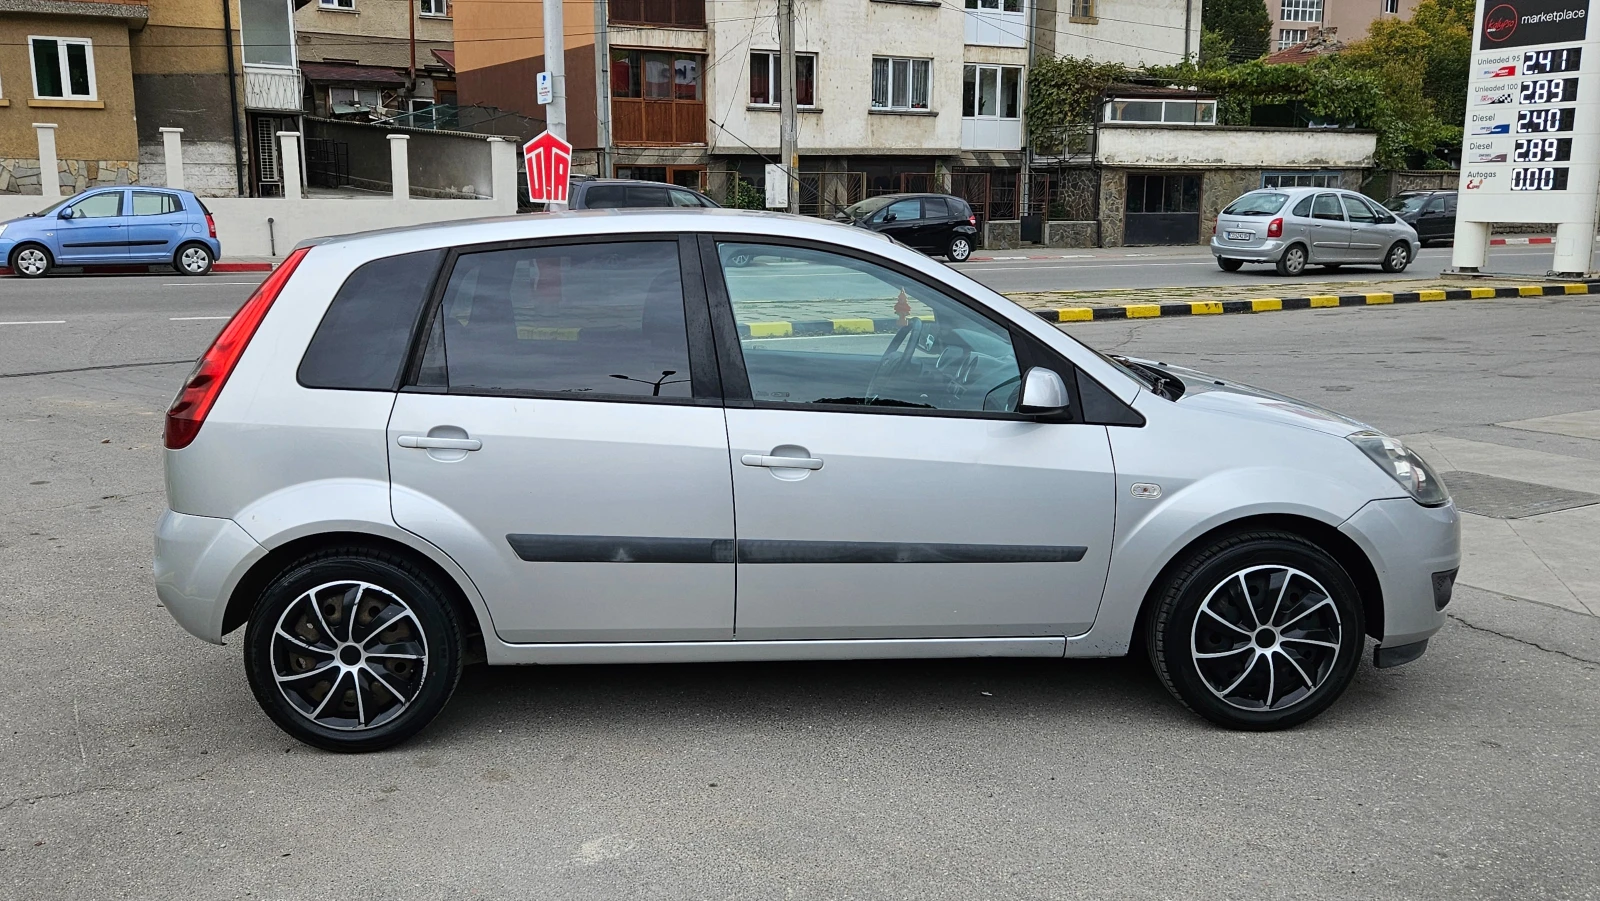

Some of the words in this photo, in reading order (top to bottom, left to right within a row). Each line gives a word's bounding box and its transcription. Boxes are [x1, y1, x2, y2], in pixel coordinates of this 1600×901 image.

[1521, 9, 1585, 24] marketplace
[1477, 56, 1510, 66] Unleaded
[1511, 55, 1521, 63] 95
[1523, 50, 1567, 75] 2.41
[1474, 84, 1506, 93] Unleaded
[1520, 79, 1564, 104] 2.89
[1472, 113, 1496, 122] Diesel
[1517, 109, 1560, 132] 2.40
[1469, 142, 1493, 150] Diesel
[1514, 138, 1557, 162] 2.89
[1467, 171, 1497, 179] Autogas
[1511, 167, 1554, 190] 0.00
